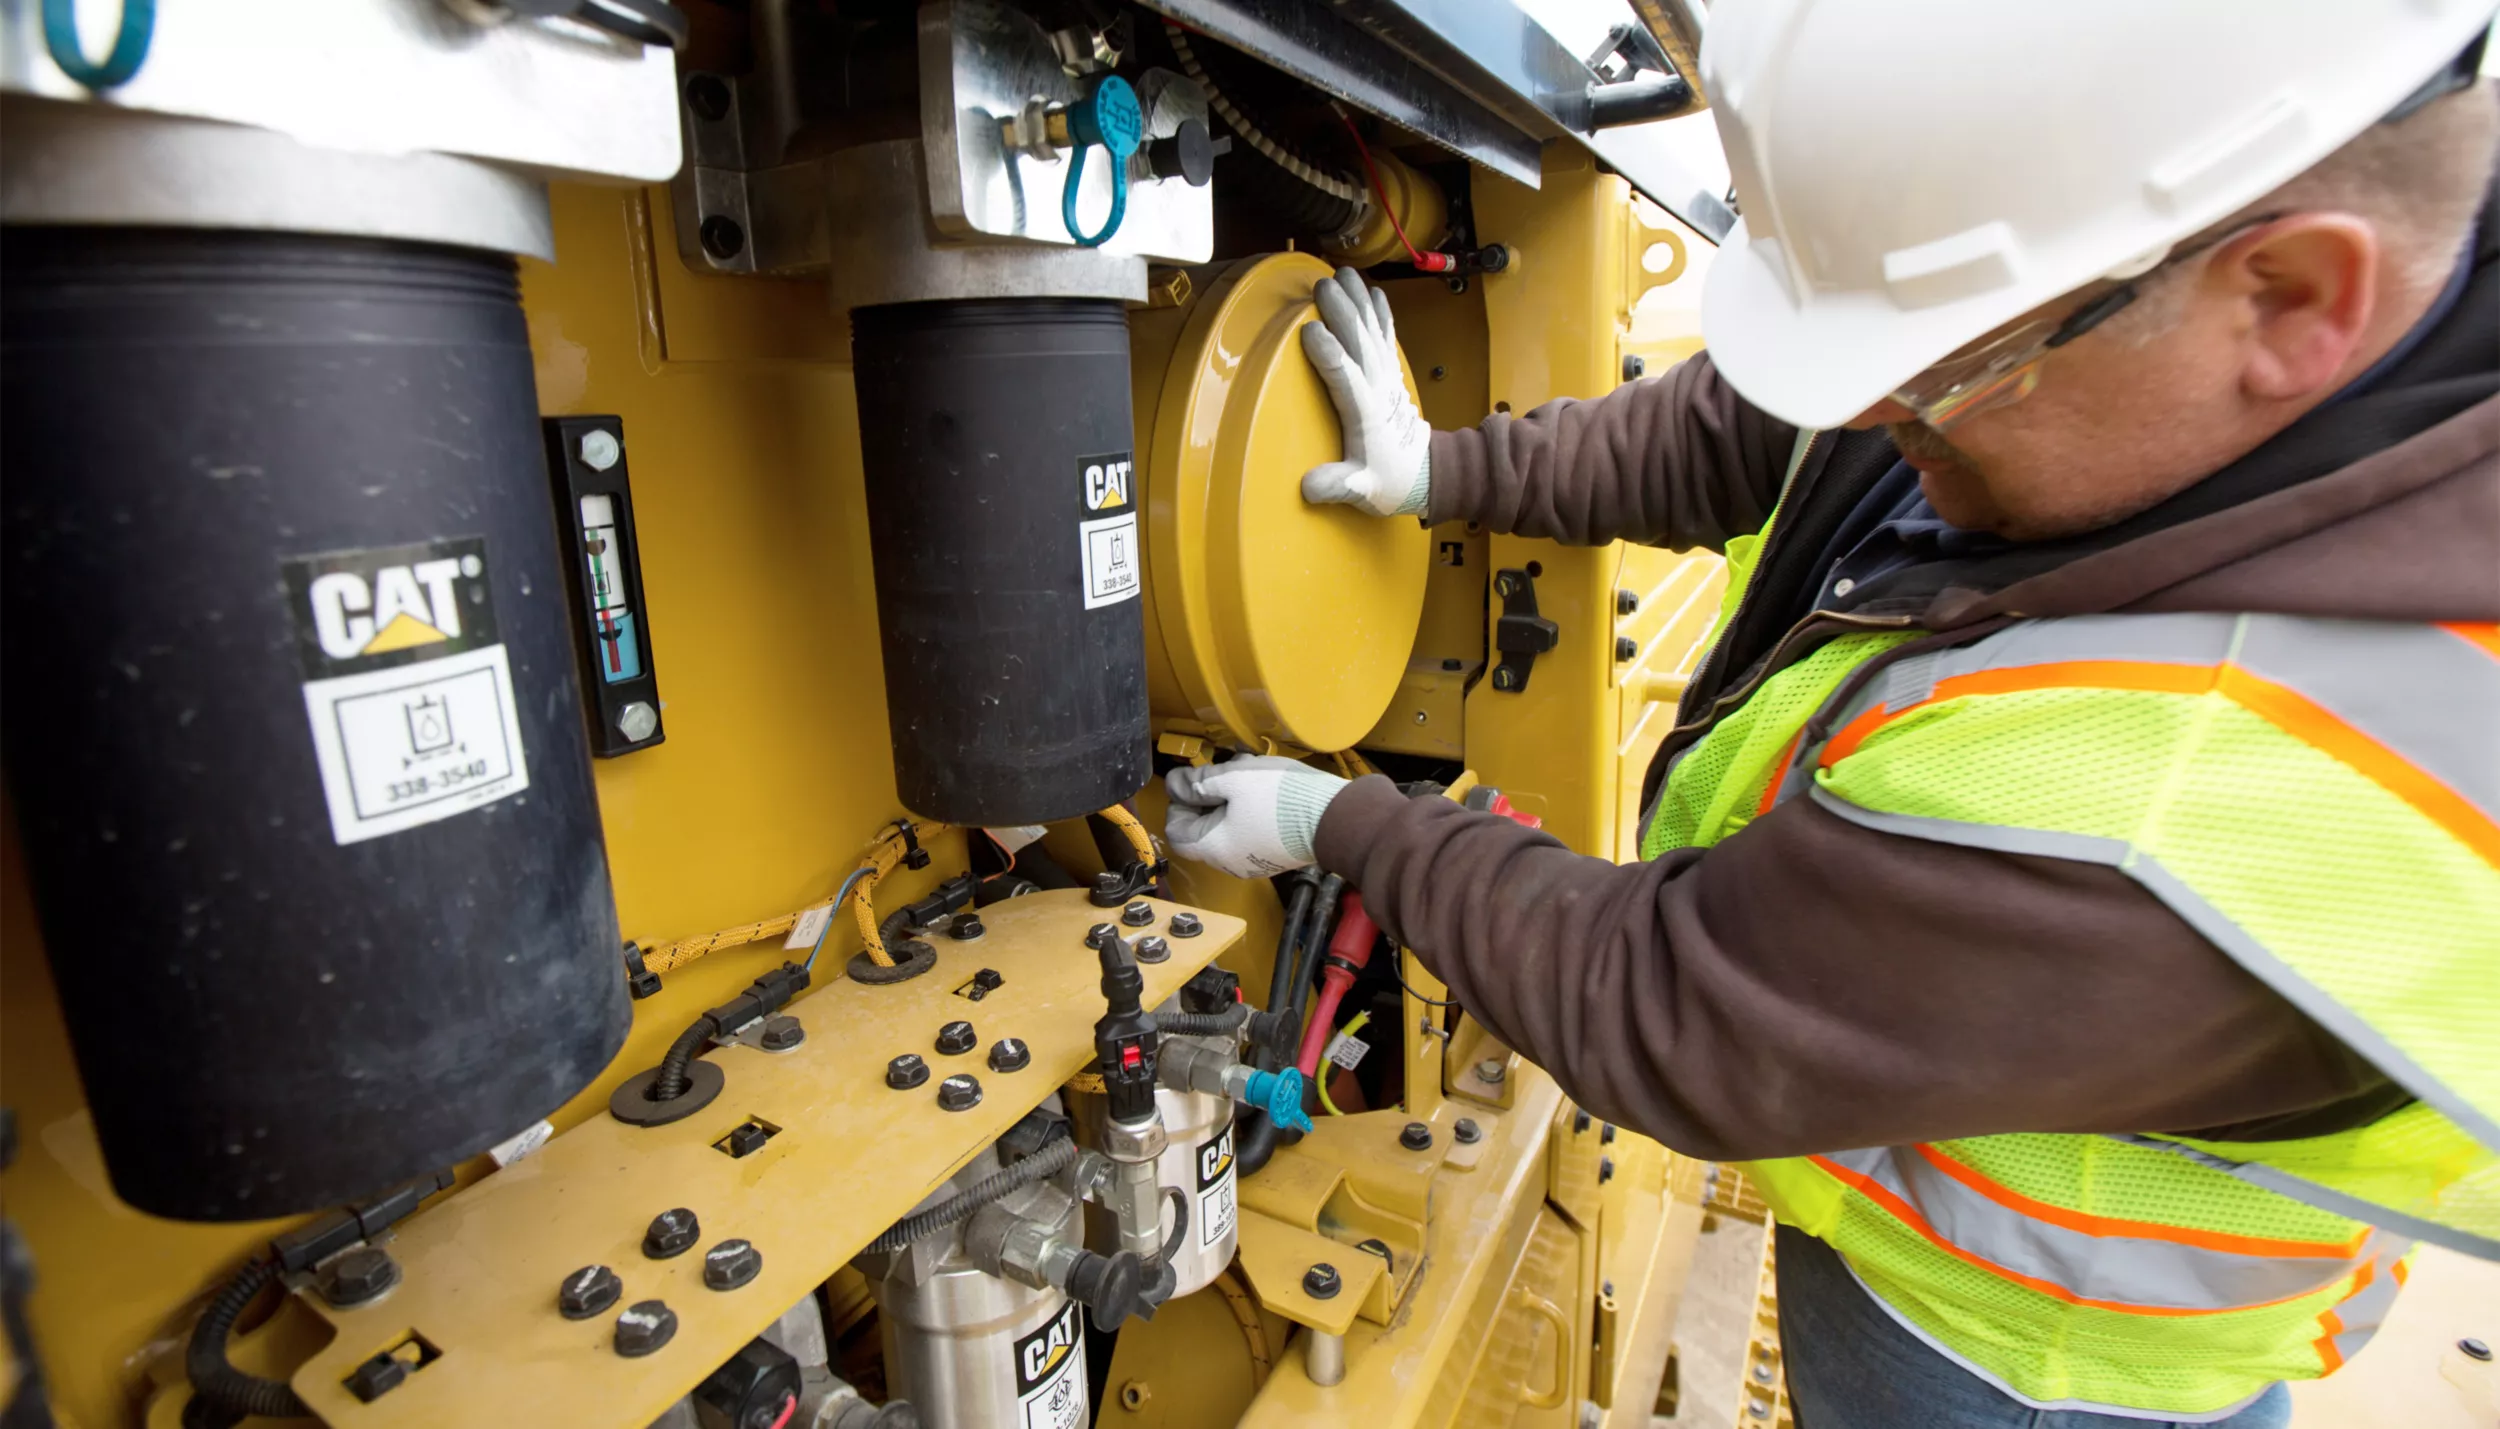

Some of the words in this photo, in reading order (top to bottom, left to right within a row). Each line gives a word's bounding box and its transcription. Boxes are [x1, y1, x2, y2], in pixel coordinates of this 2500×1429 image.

[1085, 461, 1128, 510] CAT
[309, 557, 462, 660] CAT
[1102, 573, 1132, 590] 338-3540
[1023, 1302, 1074, 1382] CAT
